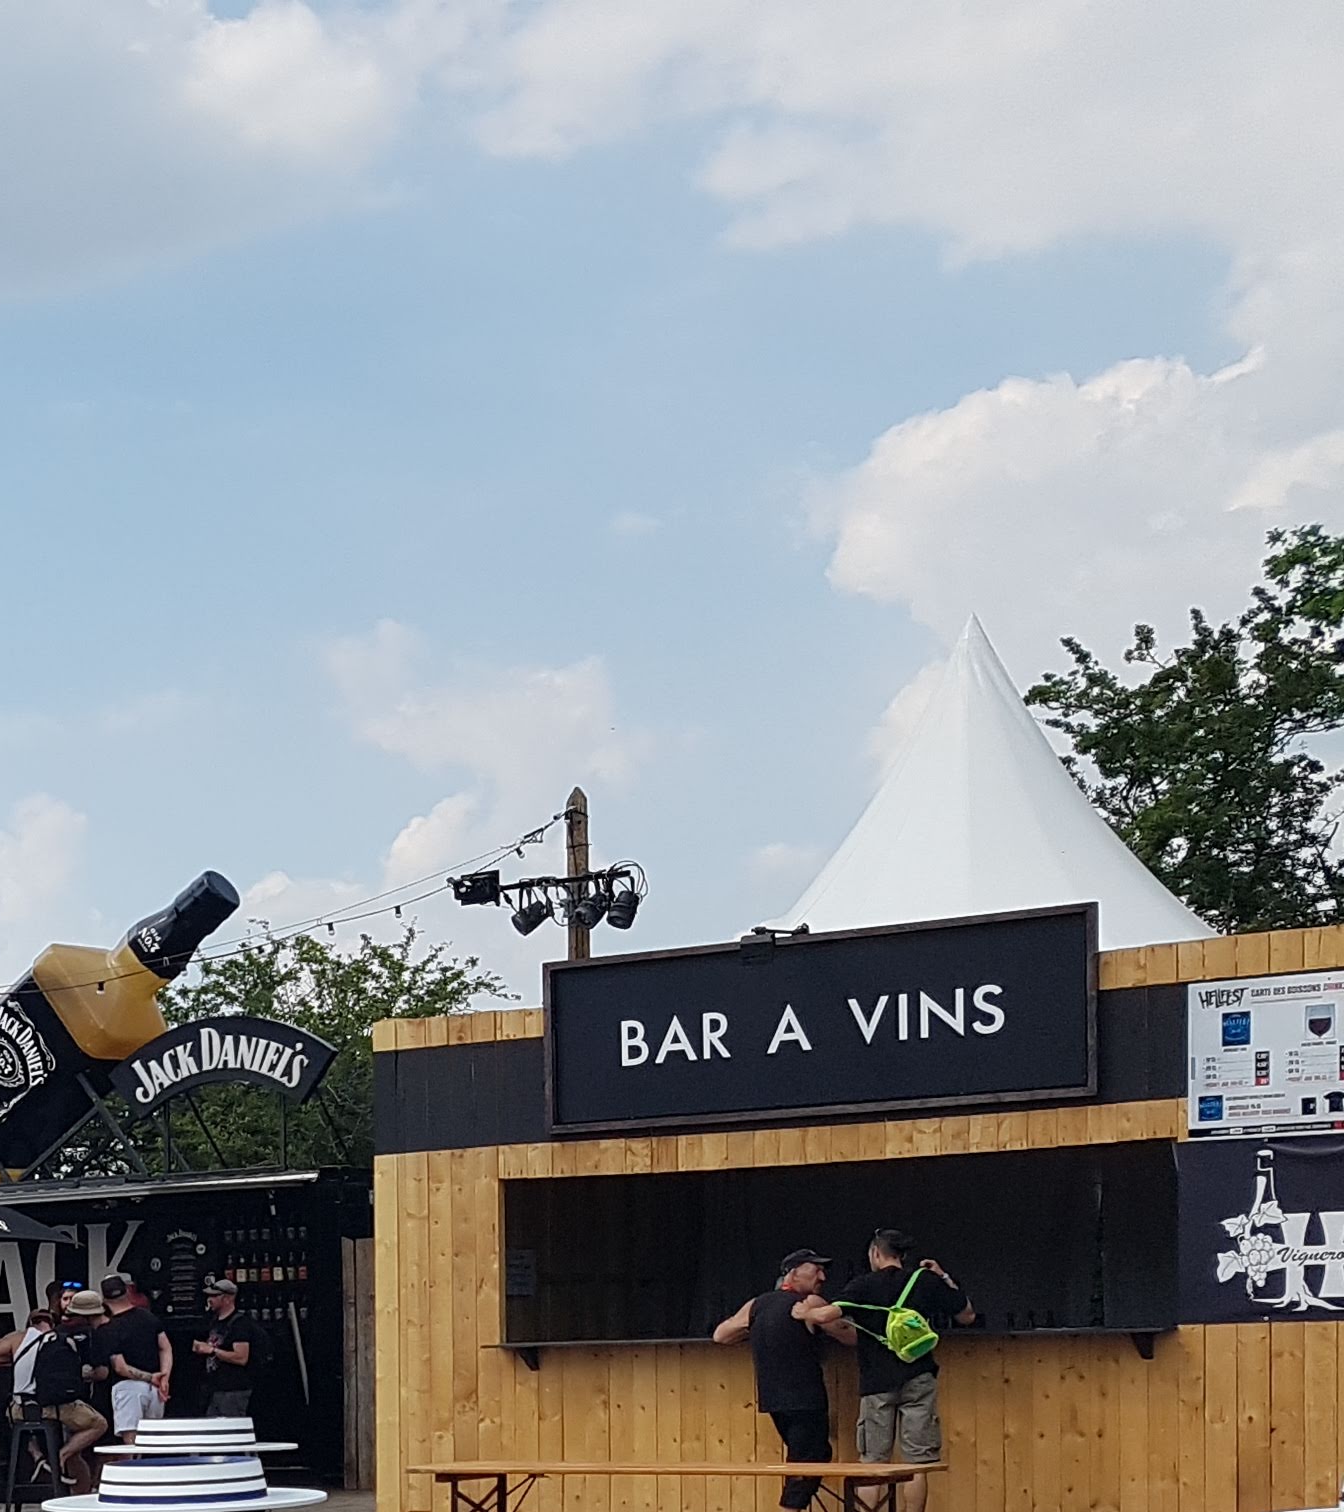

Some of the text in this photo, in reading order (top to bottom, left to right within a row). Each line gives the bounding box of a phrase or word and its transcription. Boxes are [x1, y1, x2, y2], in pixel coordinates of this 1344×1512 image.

[621, 984, 1005, 1067] BAR A VINS
[1199, 987, 1249, 1009] HELLFEST
[16, 1026, 48, 1087] DANIEL'S
[131, 1027, 309, 1103] JACK DANIEL'S
